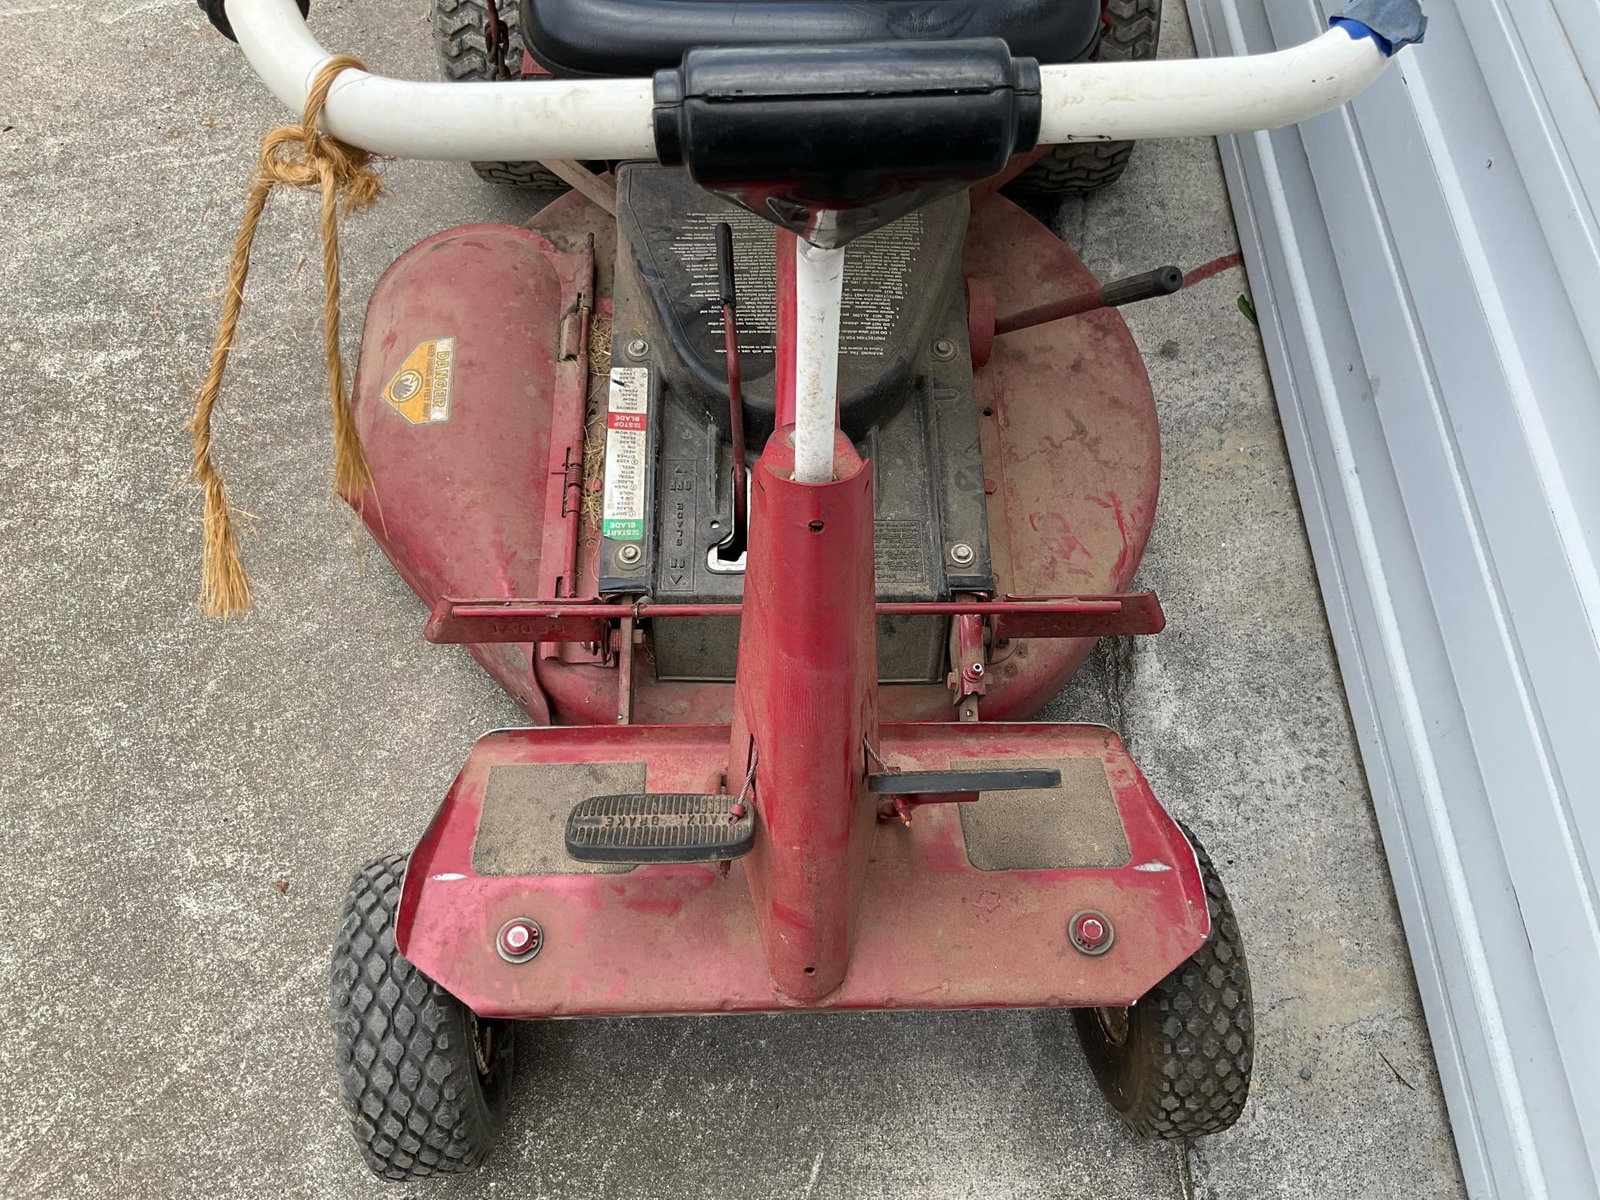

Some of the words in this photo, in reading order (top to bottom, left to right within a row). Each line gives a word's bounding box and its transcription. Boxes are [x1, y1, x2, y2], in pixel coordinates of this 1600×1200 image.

[432, 351, 450, 408] DANGER
[605, 815, 660, 827] BRAKE
[679, 814, 718, 824] AUX.
